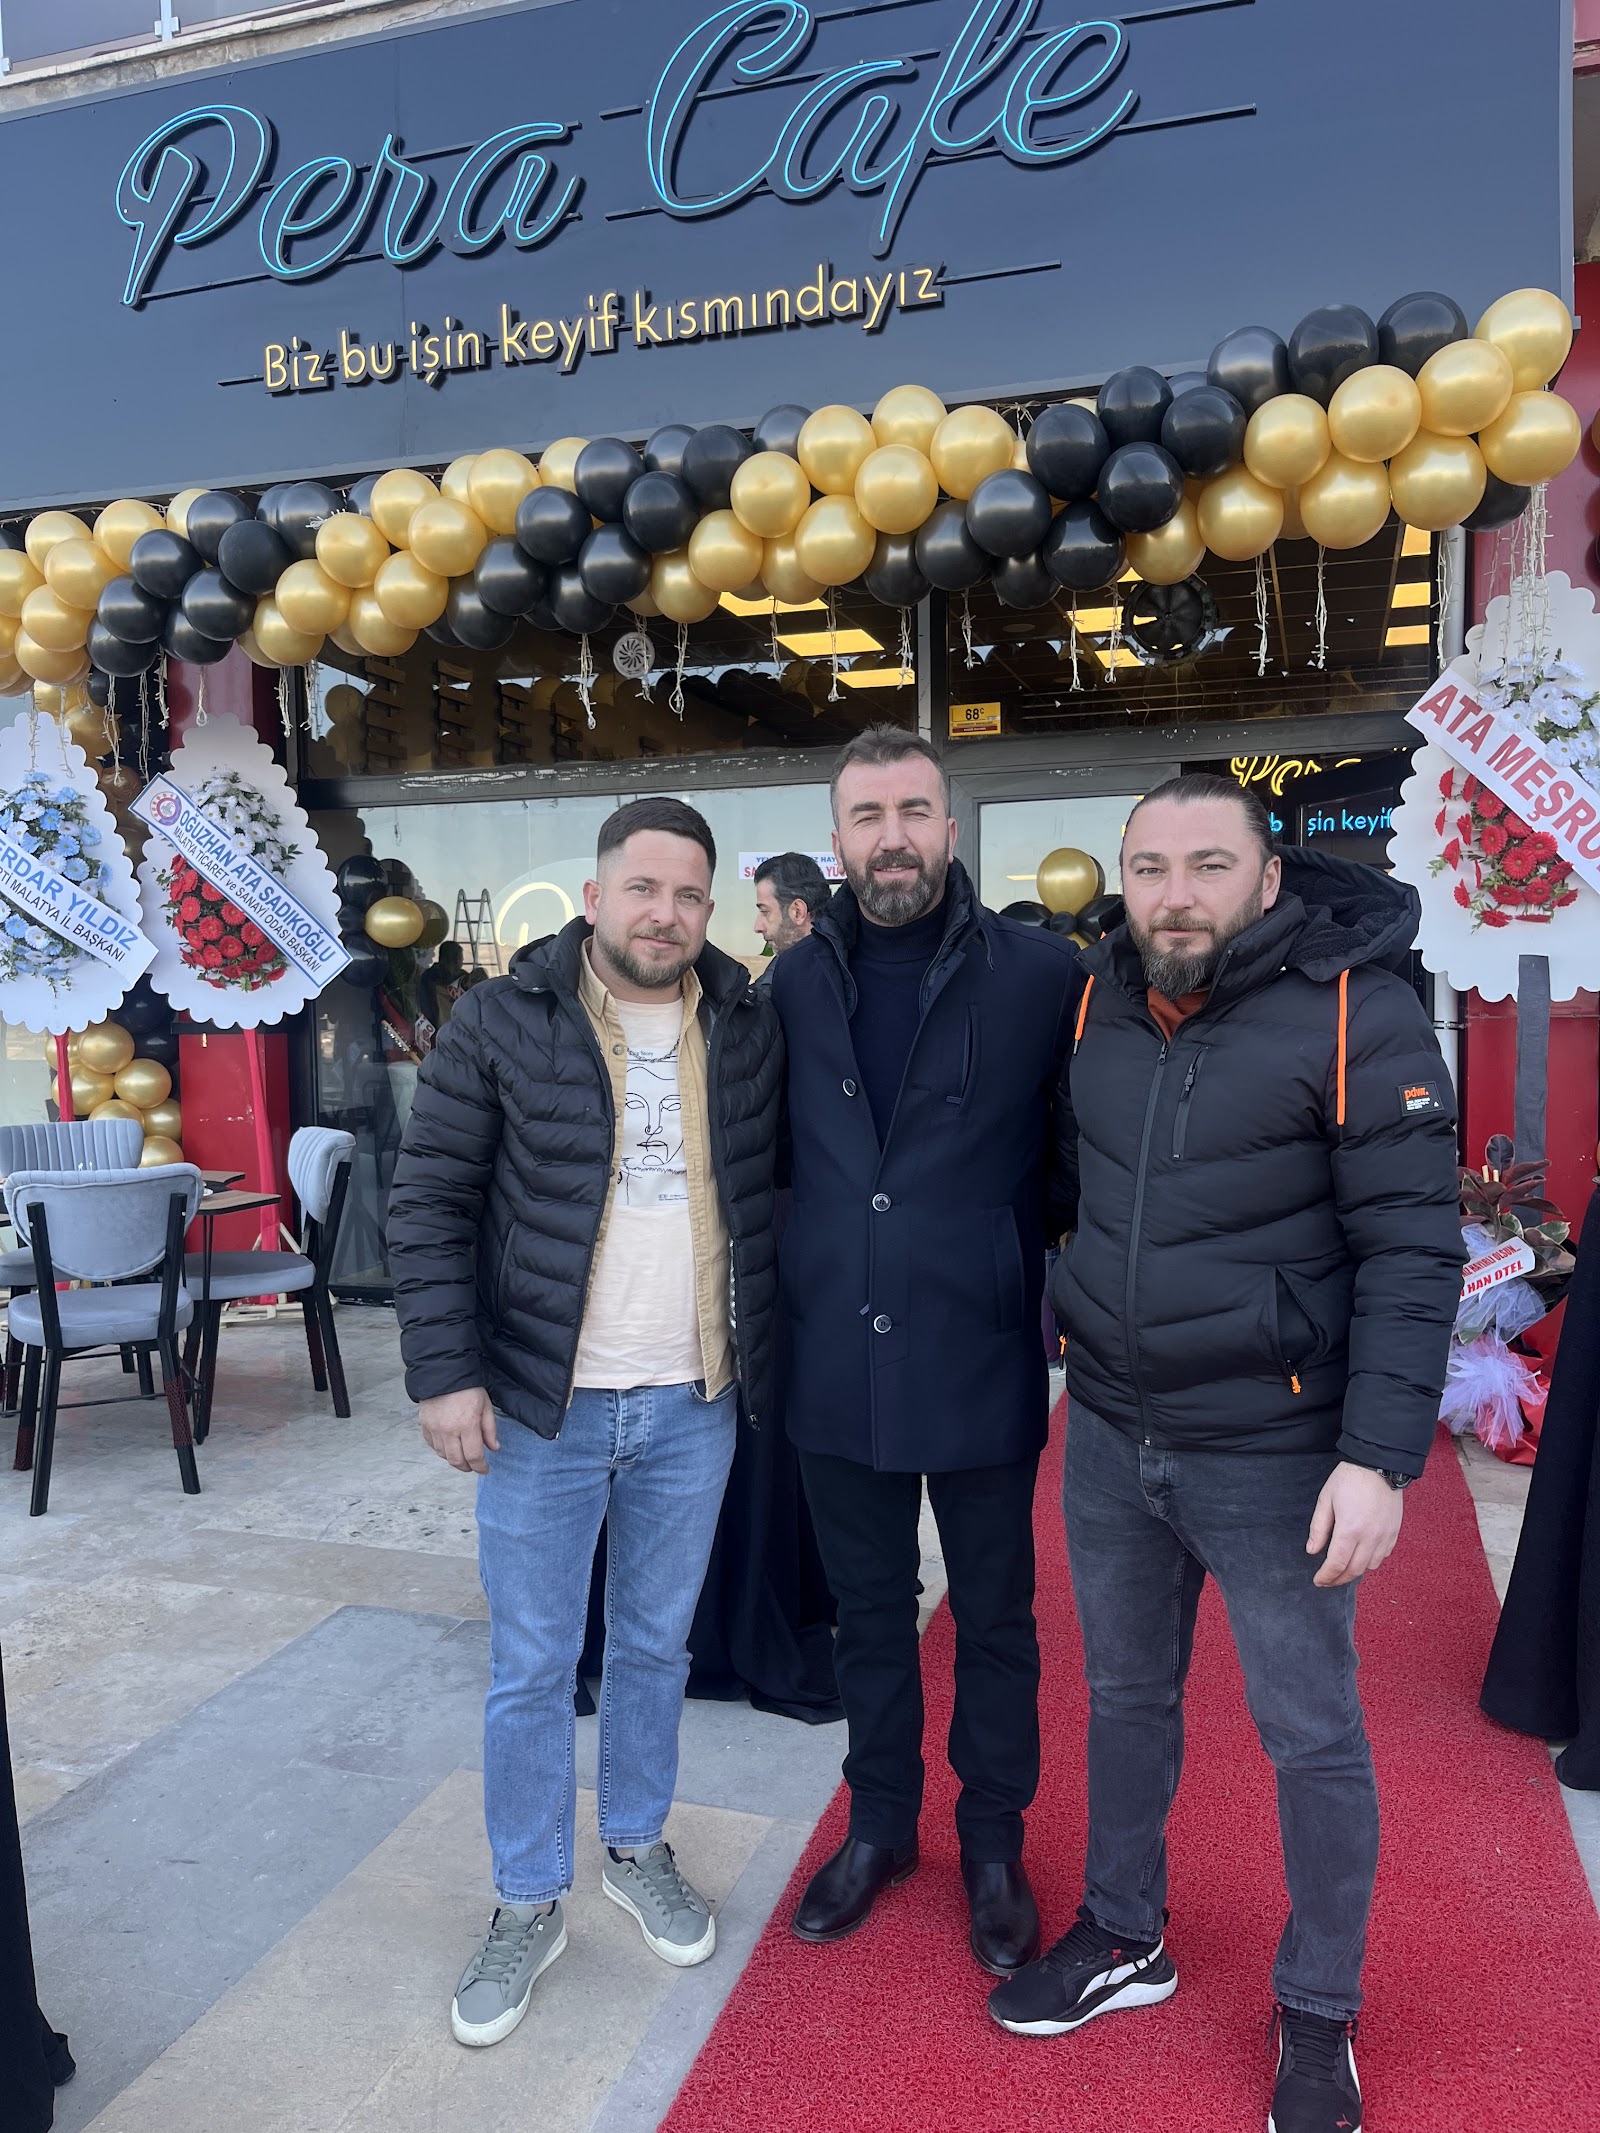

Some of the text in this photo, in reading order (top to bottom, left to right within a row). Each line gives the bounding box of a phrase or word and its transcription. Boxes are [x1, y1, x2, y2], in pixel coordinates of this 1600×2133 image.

[115, 0, 1138, 306] Pera Cafe
[264, 262, 940, 389] Biz bu işin keyif kısmındayız
[1307, 809, 1336, 837] şin
[1341, 806, 1393, 837] keyif
[1417, 683, 1600, 873] ATA MEŞRU
[9, 879, 62, 922] MALATYA
[59, 912, 71, 930] İL
[72, 923, 126, 963] BAŞKANI
[67, 892, 139, 952] YILDIZ
[173, 825, 322, 973] MALATYA TİCARET ve SANAYİ ODASI BAŞKANI
[180, 810, 337, 963] OĞUZHAN ATA SADIKOĞLU
[1466, 1274, 1492, 1294] HAN
[1494, 1259, 1524, 1281] OTEL
